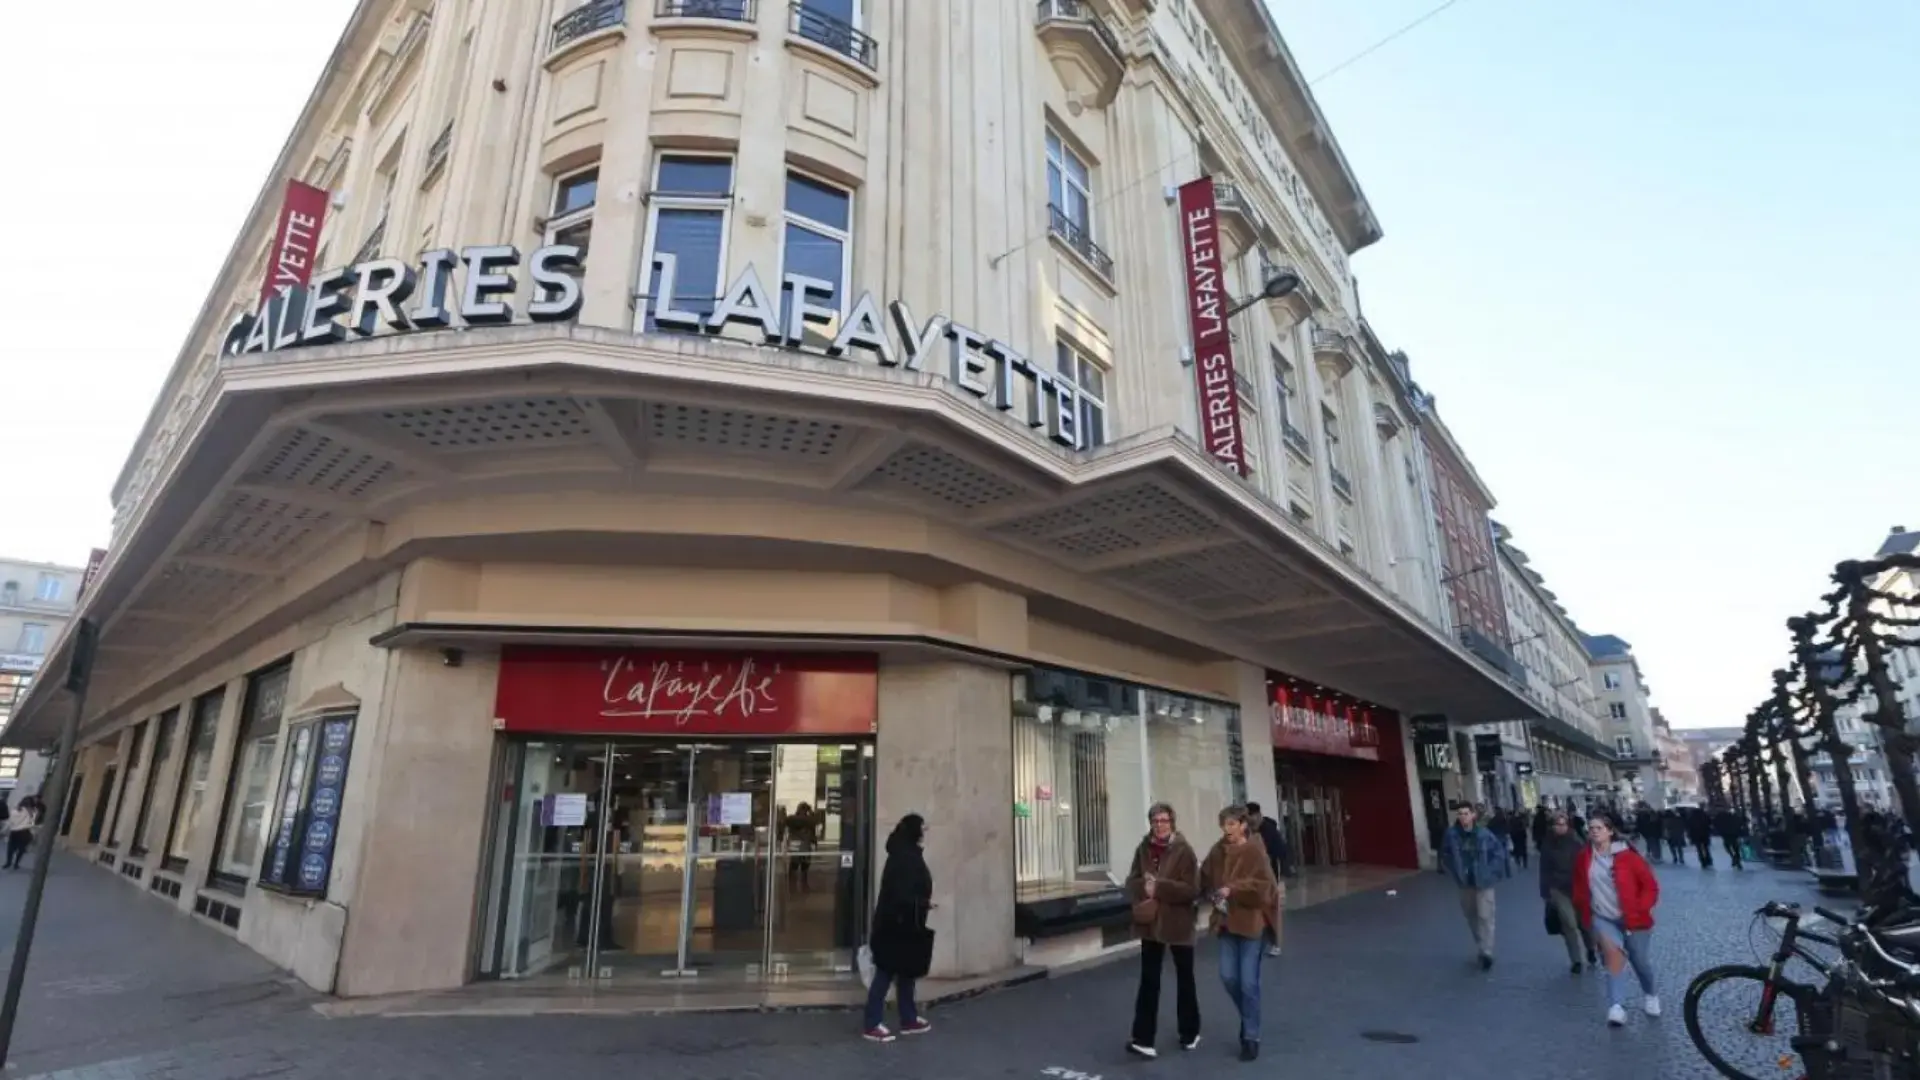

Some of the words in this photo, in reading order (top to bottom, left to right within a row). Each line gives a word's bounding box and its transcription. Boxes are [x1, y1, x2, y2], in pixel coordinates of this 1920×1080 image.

[217, 244, 584, 360] GALERIES
[651, 251, 1085, 451] LAFAYETTE
[1187, 206, 1222, 339] LAFAYETTE
